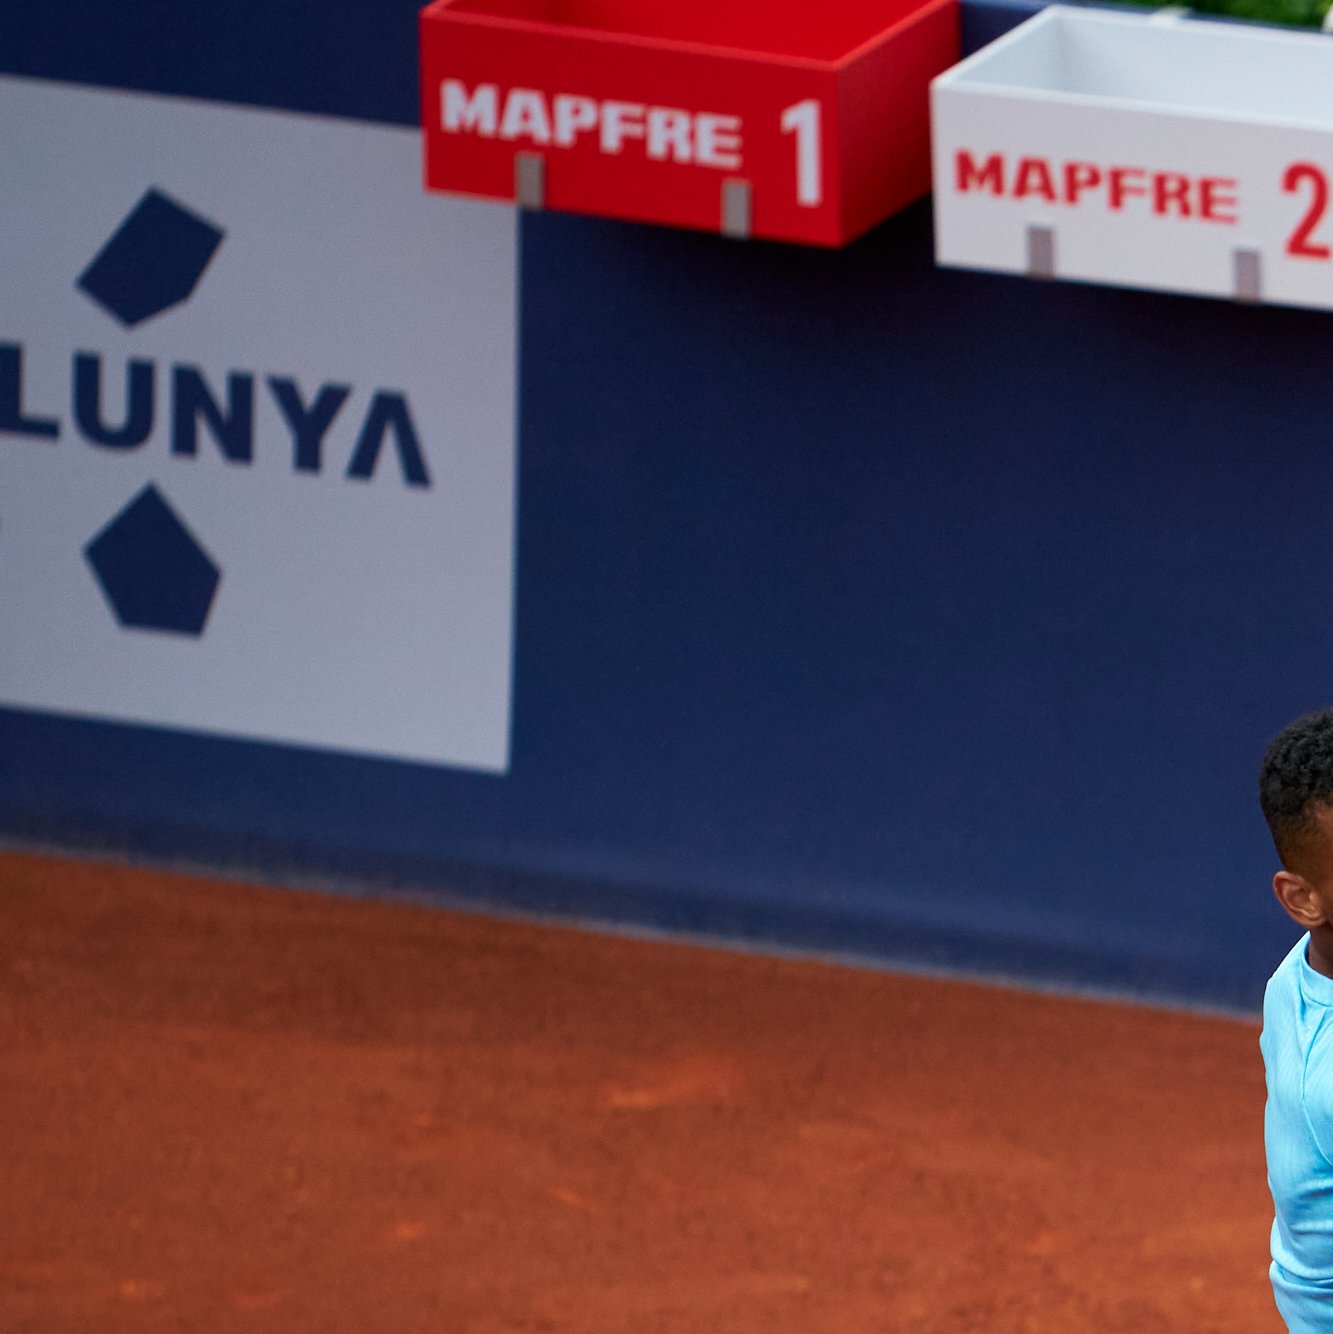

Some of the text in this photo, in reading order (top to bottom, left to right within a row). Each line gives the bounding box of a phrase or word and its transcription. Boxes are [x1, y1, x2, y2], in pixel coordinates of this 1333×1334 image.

[440, 80, 821, 206] MAPFRE 1
[954, 149, 1332, 260] MAPFRE 2
